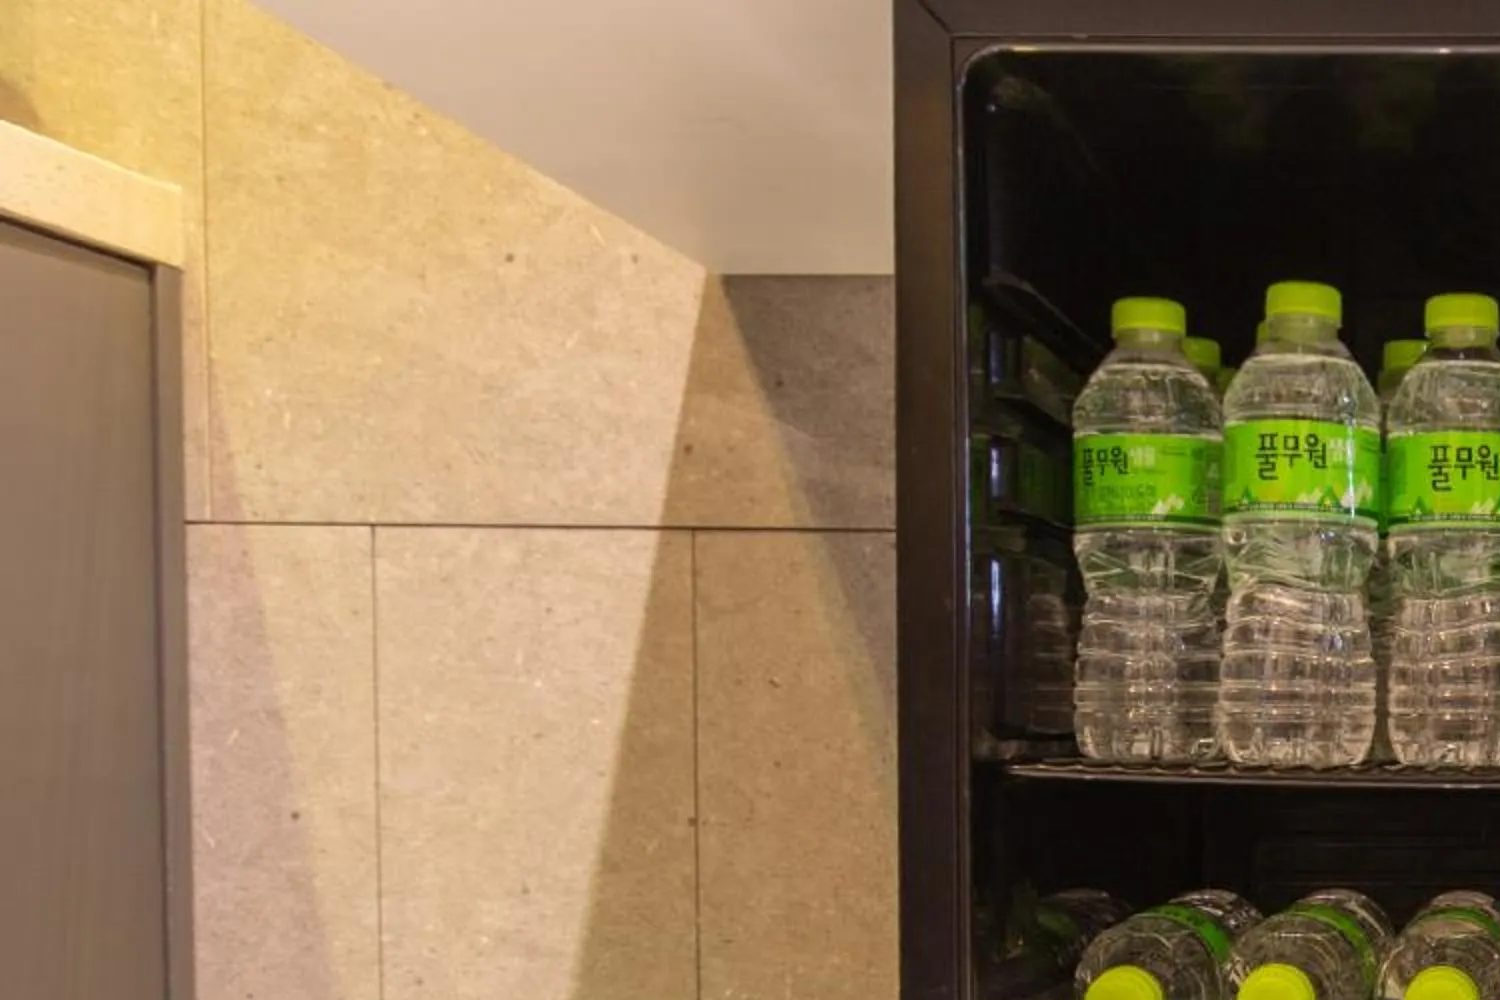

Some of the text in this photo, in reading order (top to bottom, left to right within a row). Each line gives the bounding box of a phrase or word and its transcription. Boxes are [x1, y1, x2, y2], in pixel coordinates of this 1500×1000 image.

[1083, 445, 1129, 486] 풀무원
[1255, 432, 1328, 480] 풀무원
[1428, 444, 1499, 491] 풀무원
